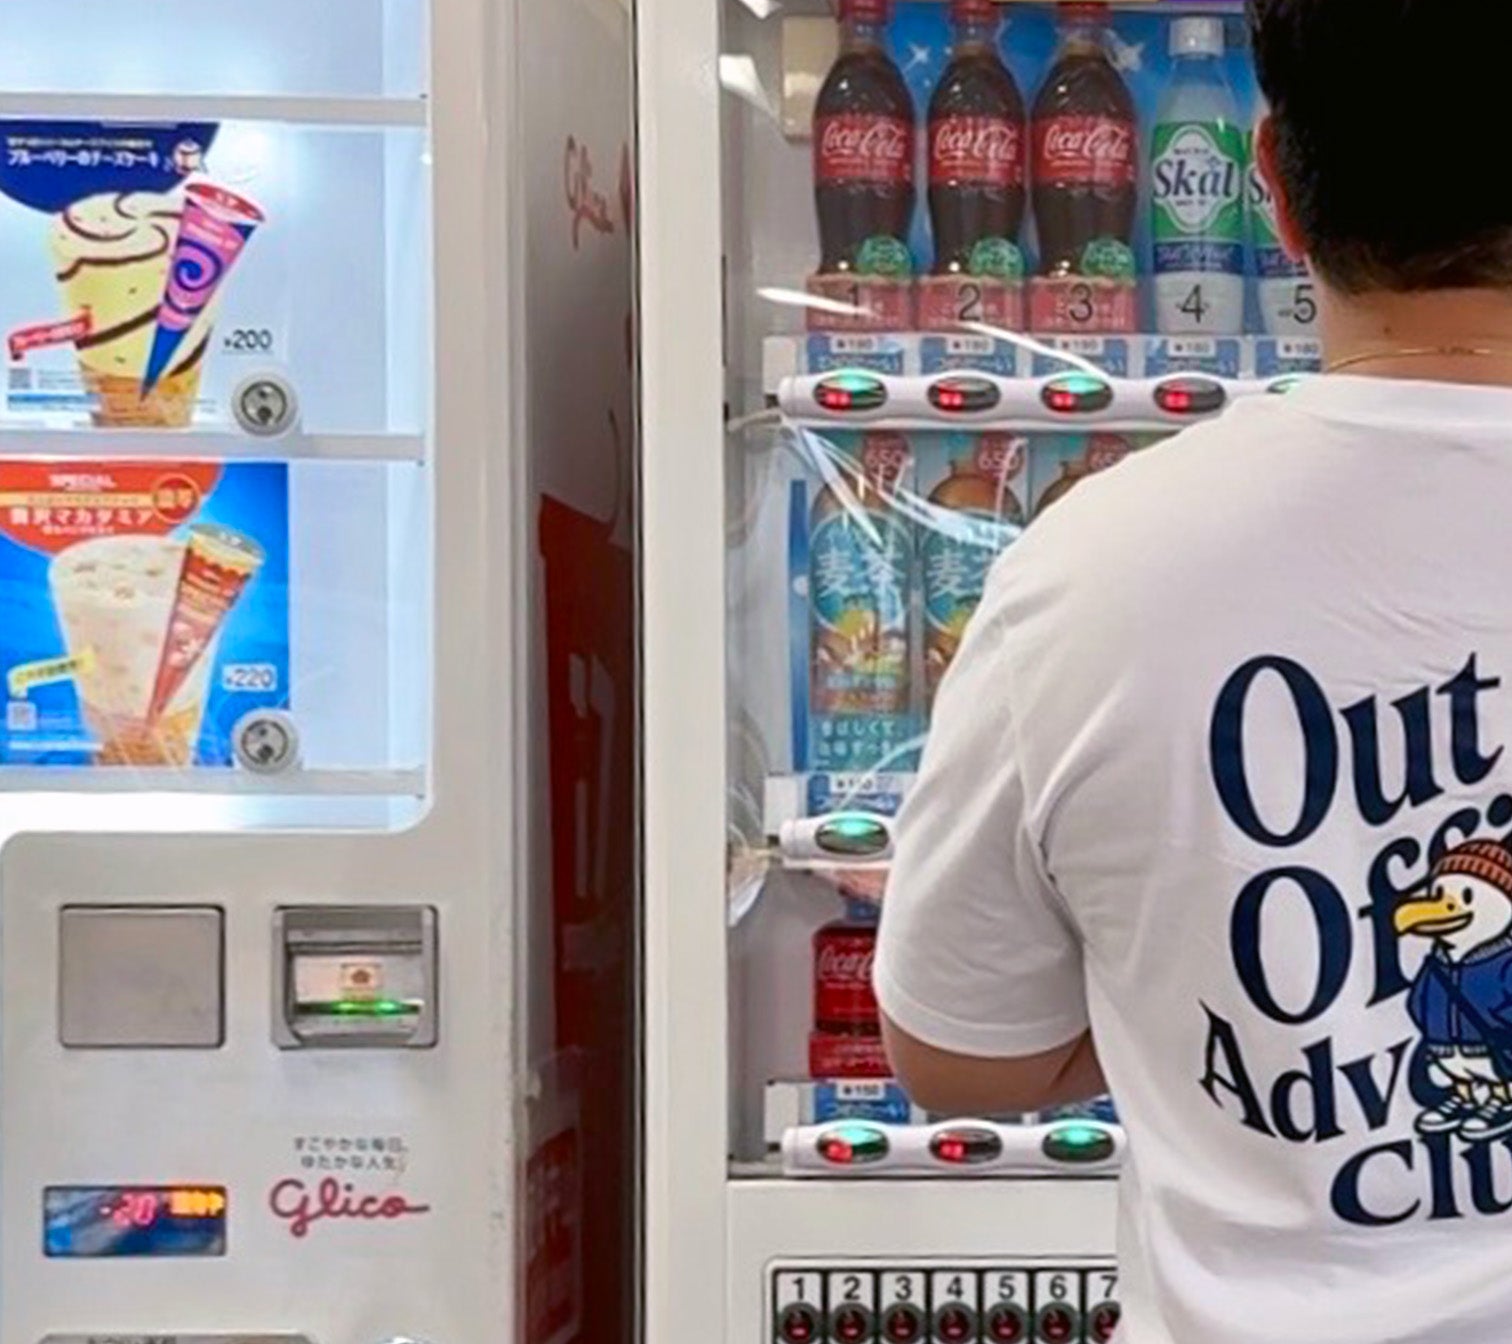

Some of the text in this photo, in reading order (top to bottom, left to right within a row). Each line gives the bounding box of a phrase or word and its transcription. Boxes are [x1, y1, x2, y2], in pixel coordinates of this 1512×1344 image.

[957, 282, 982, 322] 2
[1068, 283, 1094, 323] 3
[1180, 283, 1205, 323] 4
[1293, 284, 1317, 324] 5
[1208, 651, 1505, 849] Out
[269, 1177, 430, 1237] Glico
[791, 1276, 806, 1301] 1
[843, 1276, 861, 1301] 2
[895, 1276, 912, 1301] 3
[946, 1276, 965, 1301] 4
[999, 1276, 1015, 1301] 5
[1049, 1275, 1067, 1300] 6
[1100, 1275, 1118, 1299] 7
